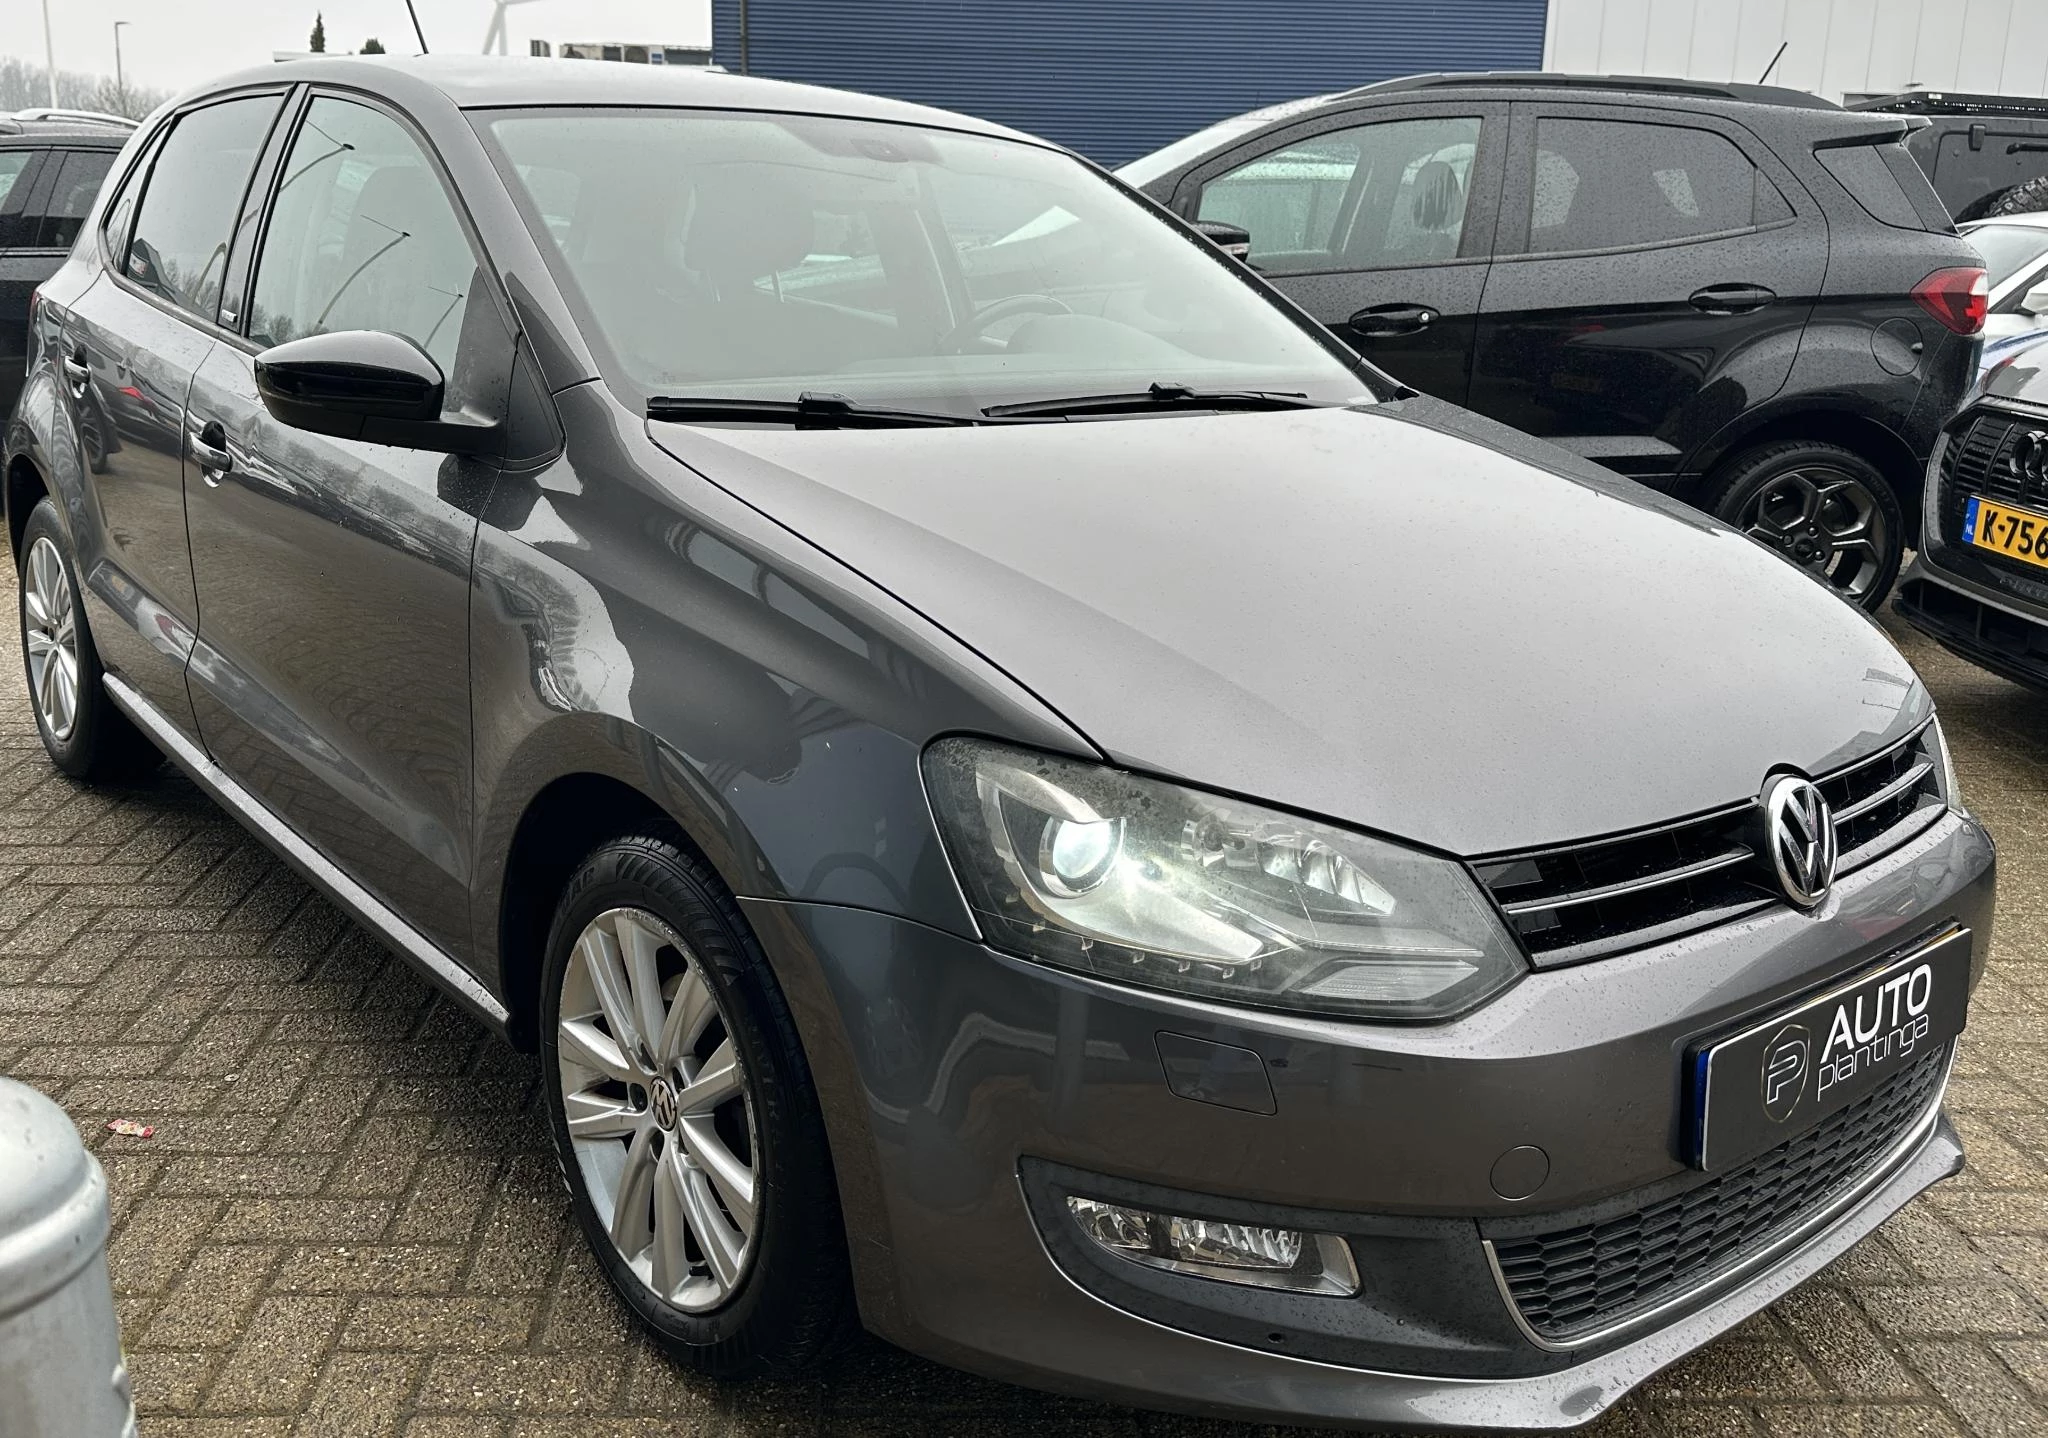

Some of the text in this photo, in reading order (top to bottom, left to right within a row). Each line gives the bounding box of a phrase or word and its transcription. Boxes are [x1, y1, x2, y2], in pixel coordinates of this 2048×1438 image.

[1965, 523, 1974, 536] NL
[1982, 510, 2048, 560] K-756
[1820, 963, 1932, 1064] AUTO
[1818, 1013, 1929, 1102] plantinga
